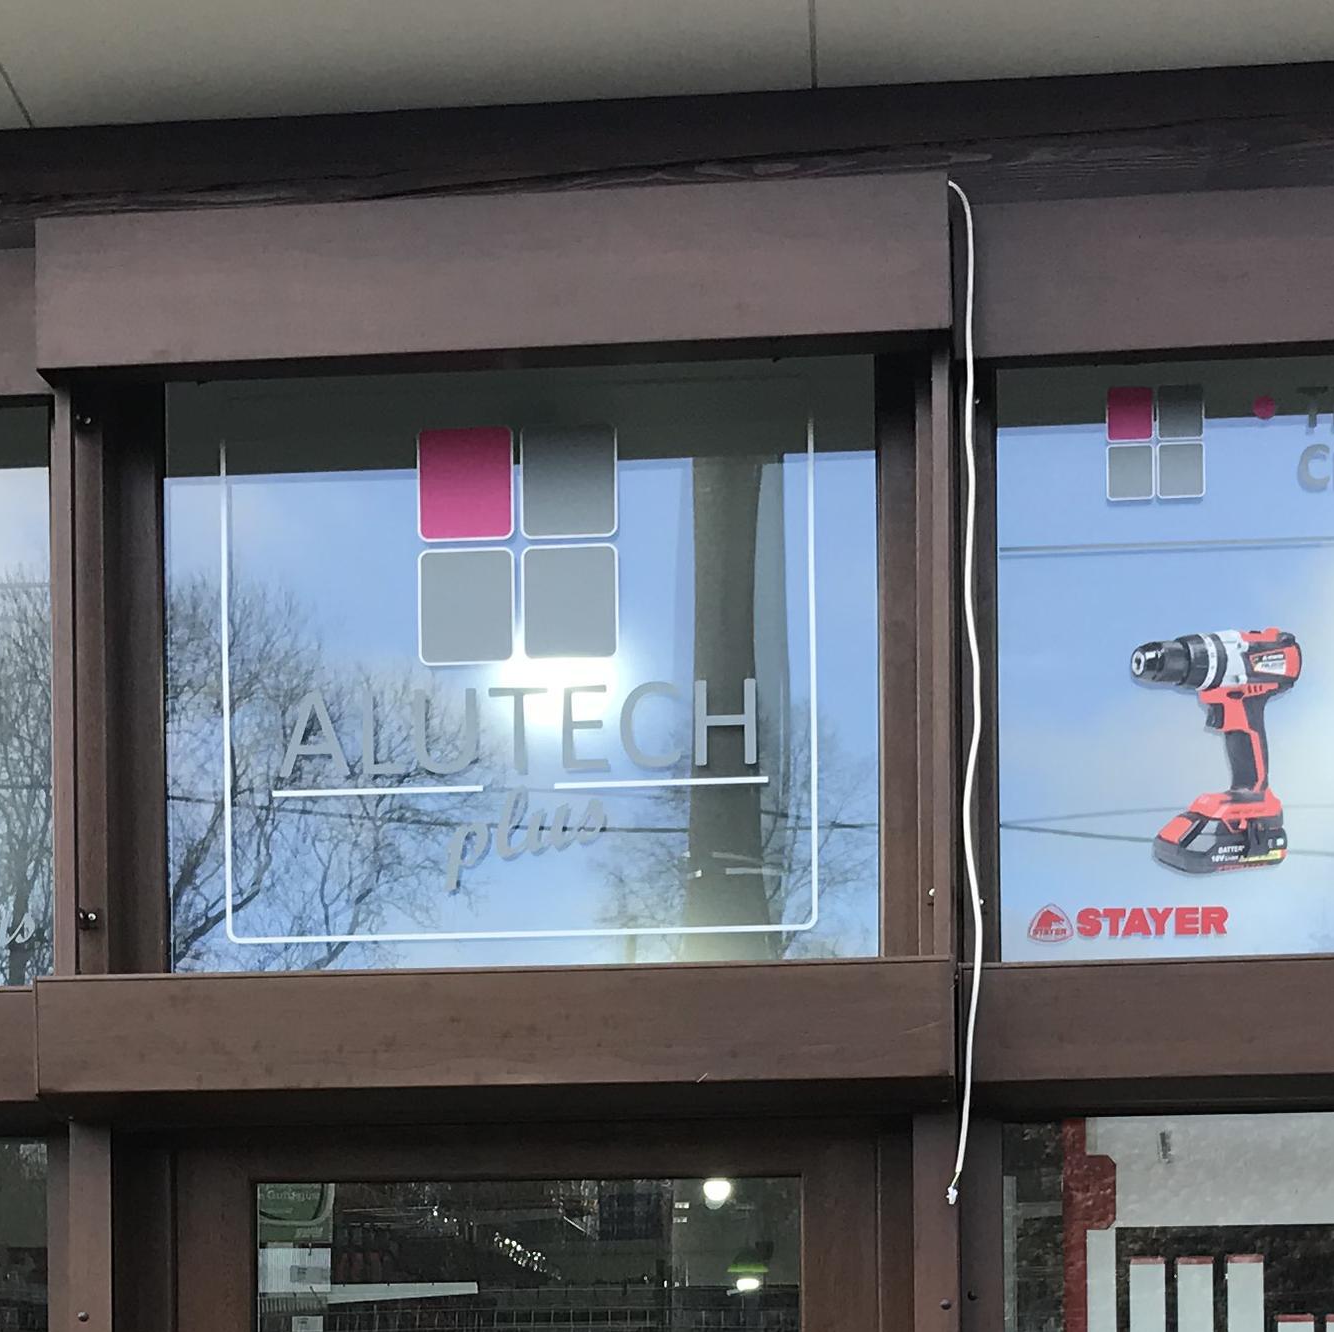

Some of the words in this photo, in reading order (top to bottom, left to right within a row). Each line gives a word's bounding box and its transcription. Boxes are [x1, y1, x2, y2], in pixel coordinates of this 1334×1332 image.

[277, 676, 758, 779] ALUTECH
[445, 787, 609, 892] plus
[1075, 906, 1229, 938] STAYER
